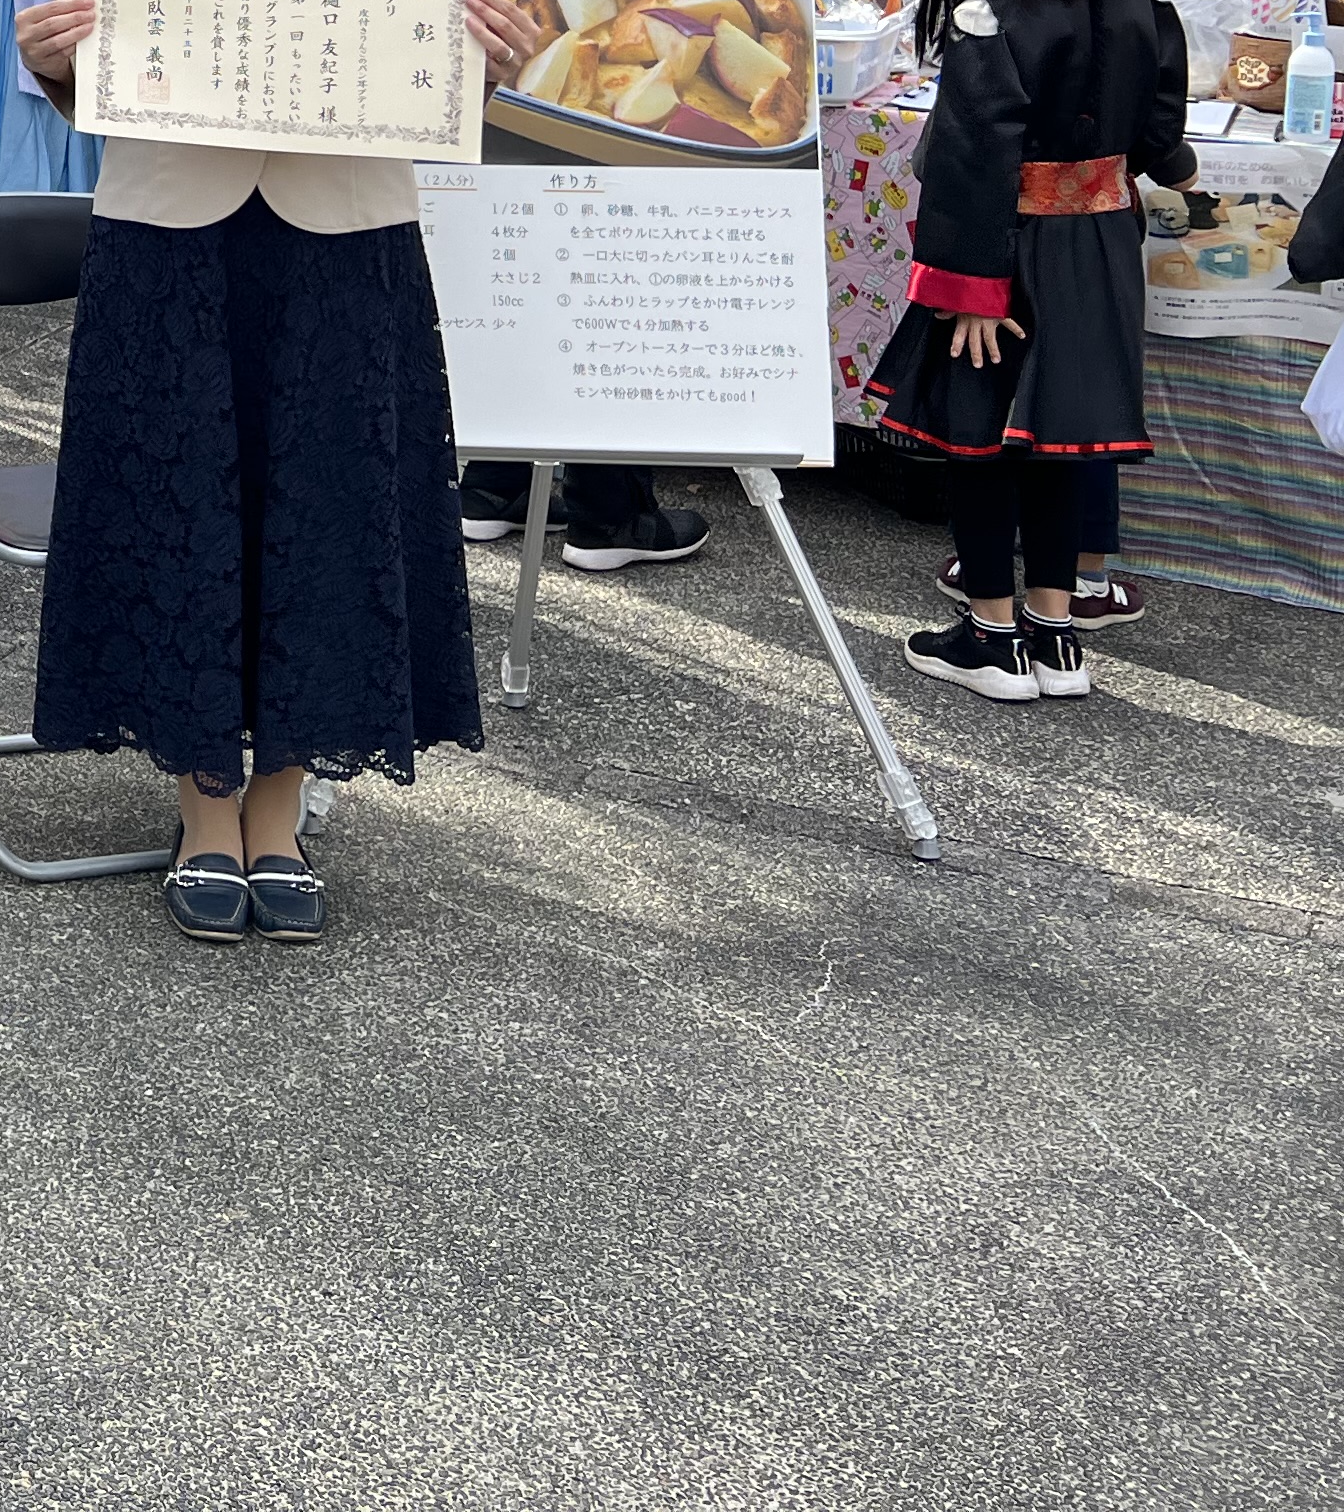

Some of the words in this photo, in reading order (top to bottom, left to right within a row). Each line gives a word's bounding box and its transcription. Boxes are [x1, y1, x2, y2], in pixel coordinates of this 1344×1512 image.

[1240, 73, 1264, 83] Dale
[549, 173, 597, 189] 作り方
[491, 225, 528, 238] 4枚分
[492, 248, 516, 261] 2個
[490, 271, 541, 284] 大さじ2
